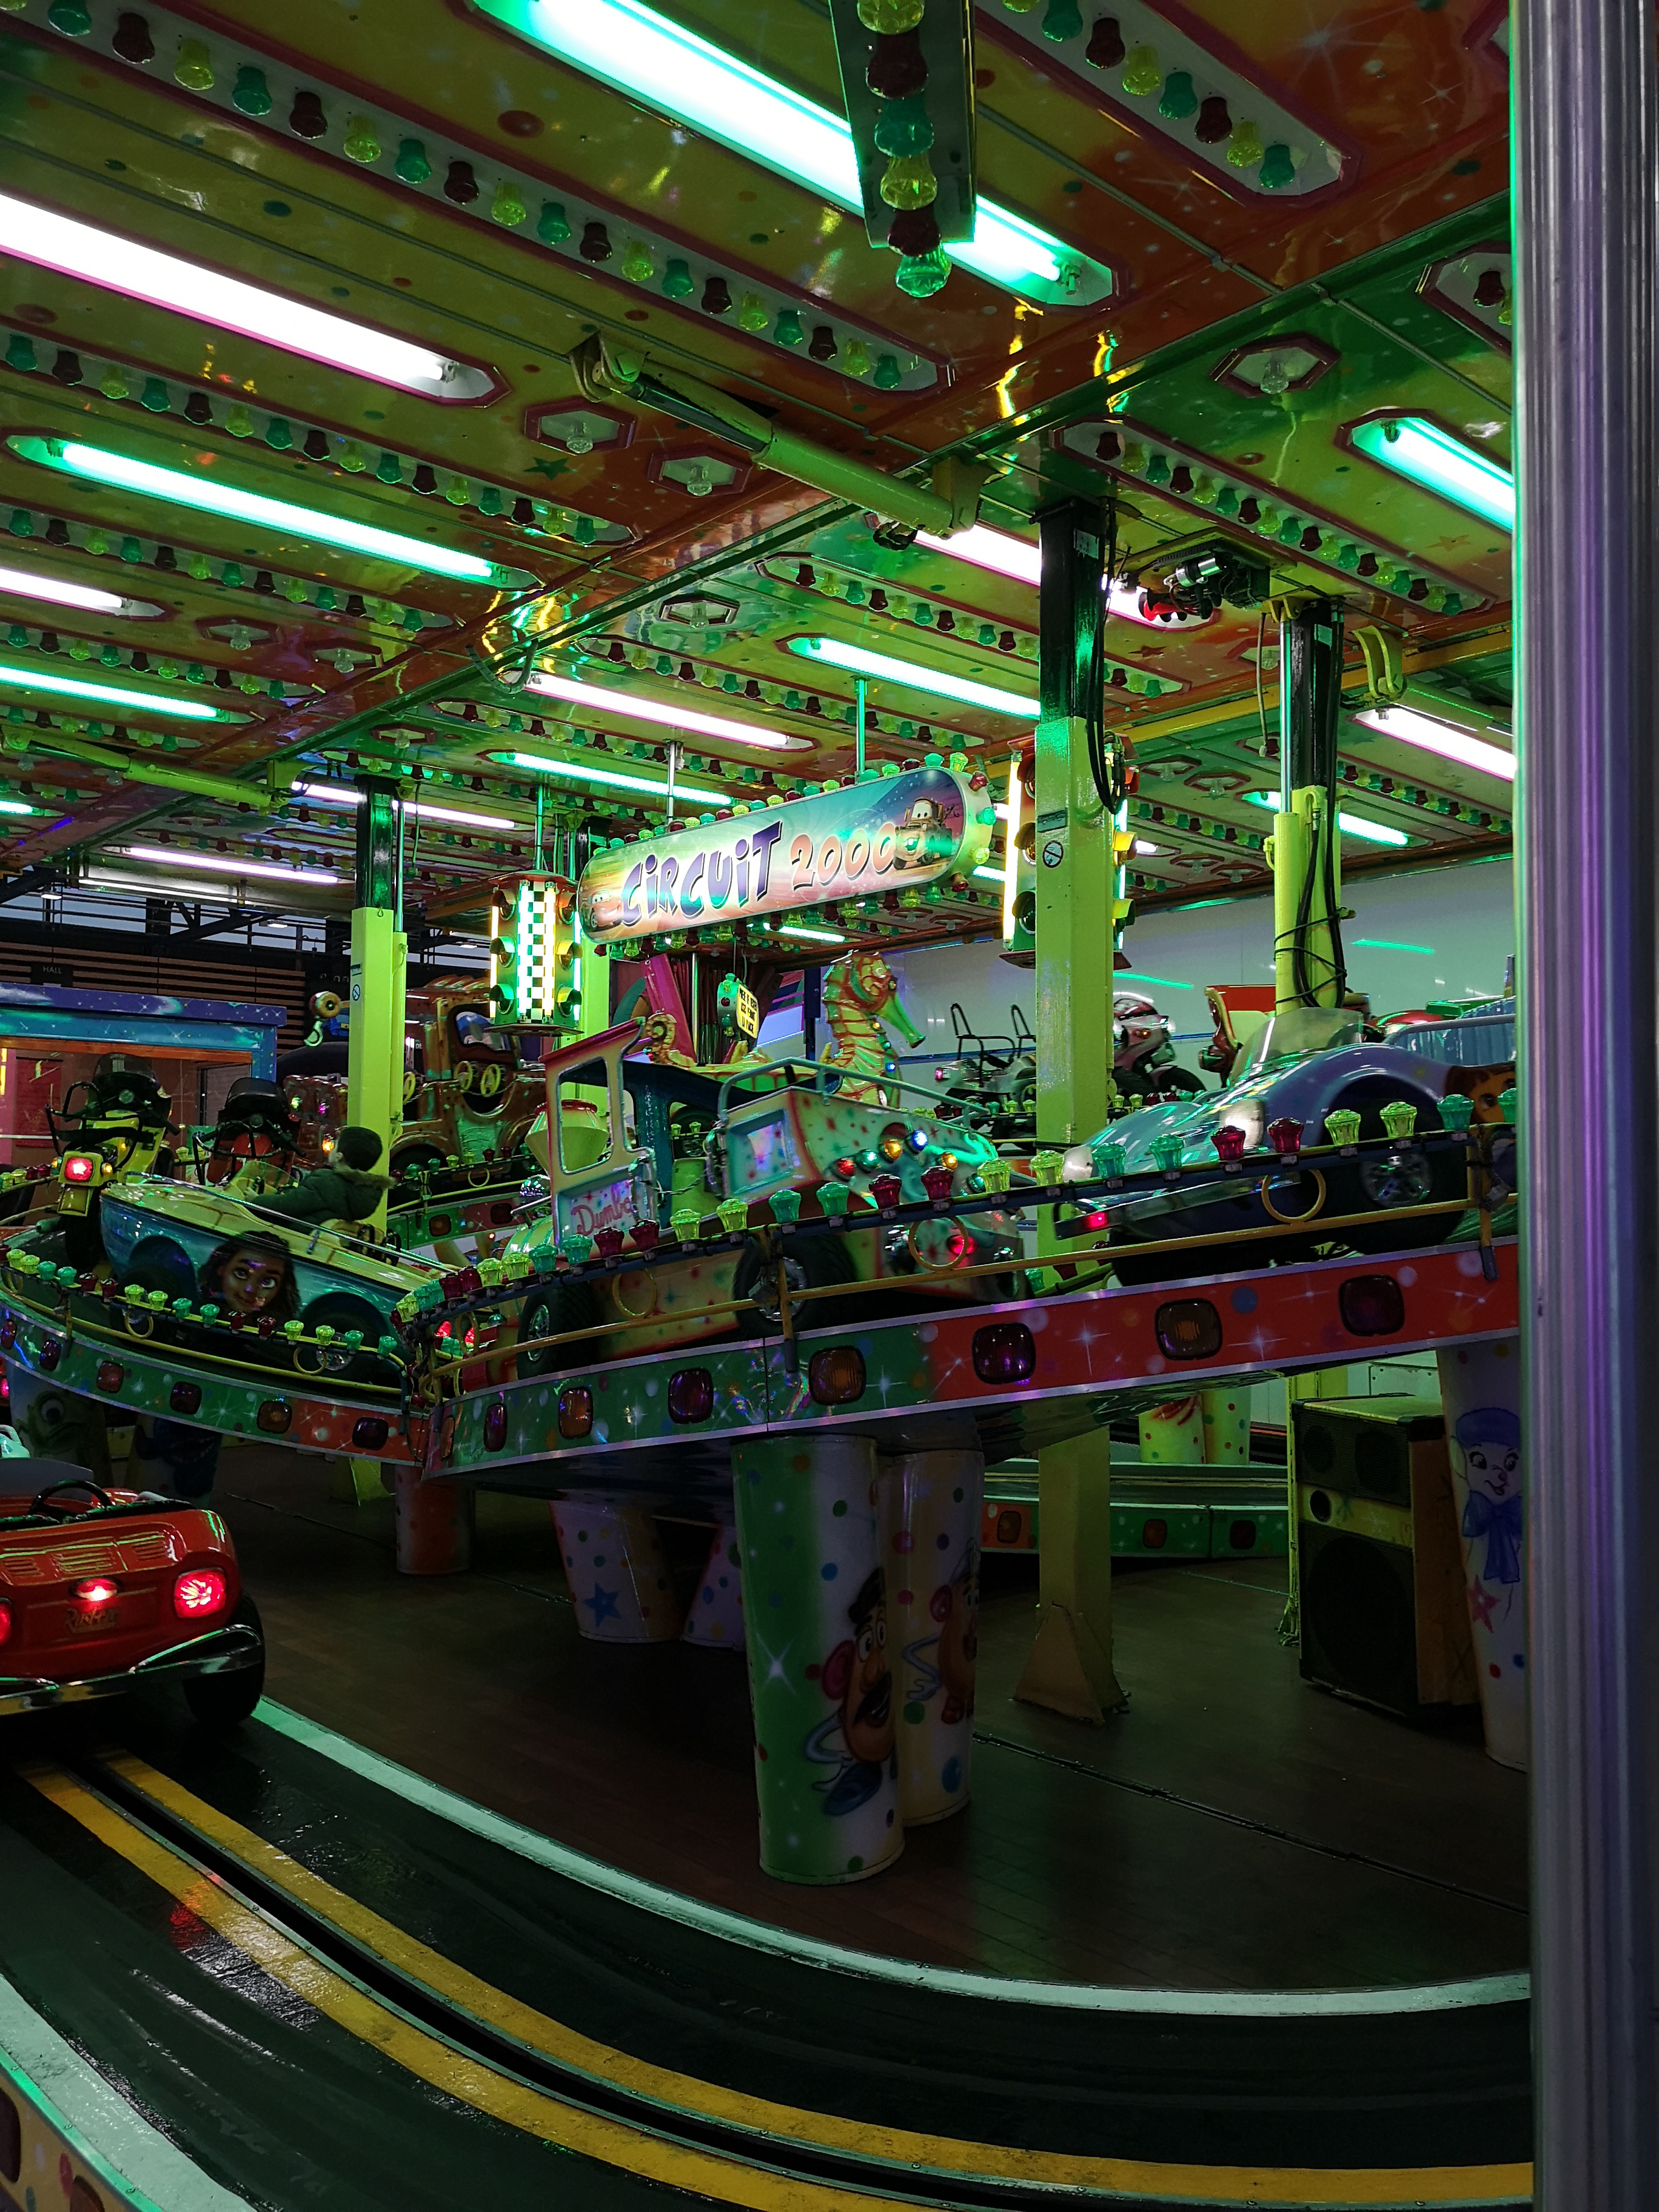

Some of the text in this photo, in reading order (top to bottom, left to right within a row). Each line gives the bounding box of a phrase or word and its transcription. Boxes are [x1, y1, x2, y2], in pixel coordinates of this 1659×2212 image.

[790, 822, 896, 890] 2000
[43, 966, 61, 974] HALL
[571, 1183, 632, 1236] Dumbo
